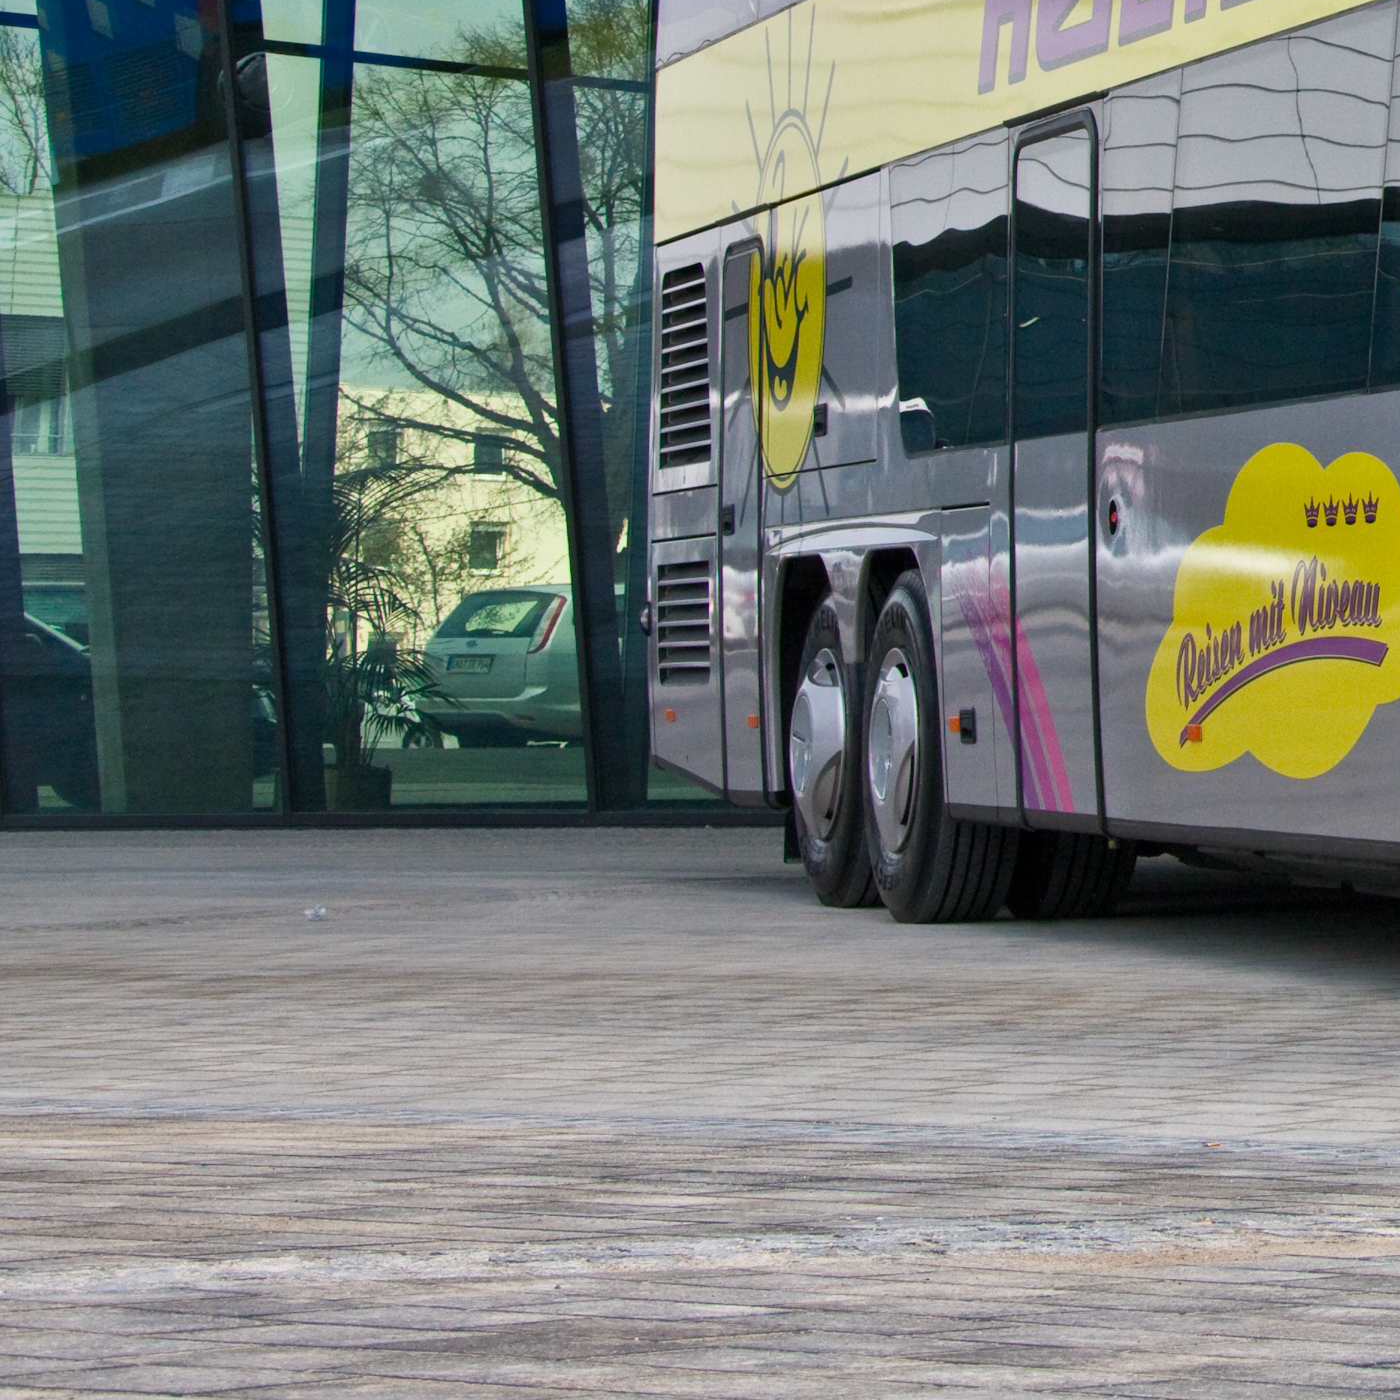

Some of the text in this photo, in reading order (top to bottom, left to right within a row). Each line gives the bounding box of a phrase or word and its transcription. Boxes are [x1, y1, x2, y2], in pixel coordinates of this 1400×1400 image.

[1176, 555, 1382, 710] Reisen mit Niveau
